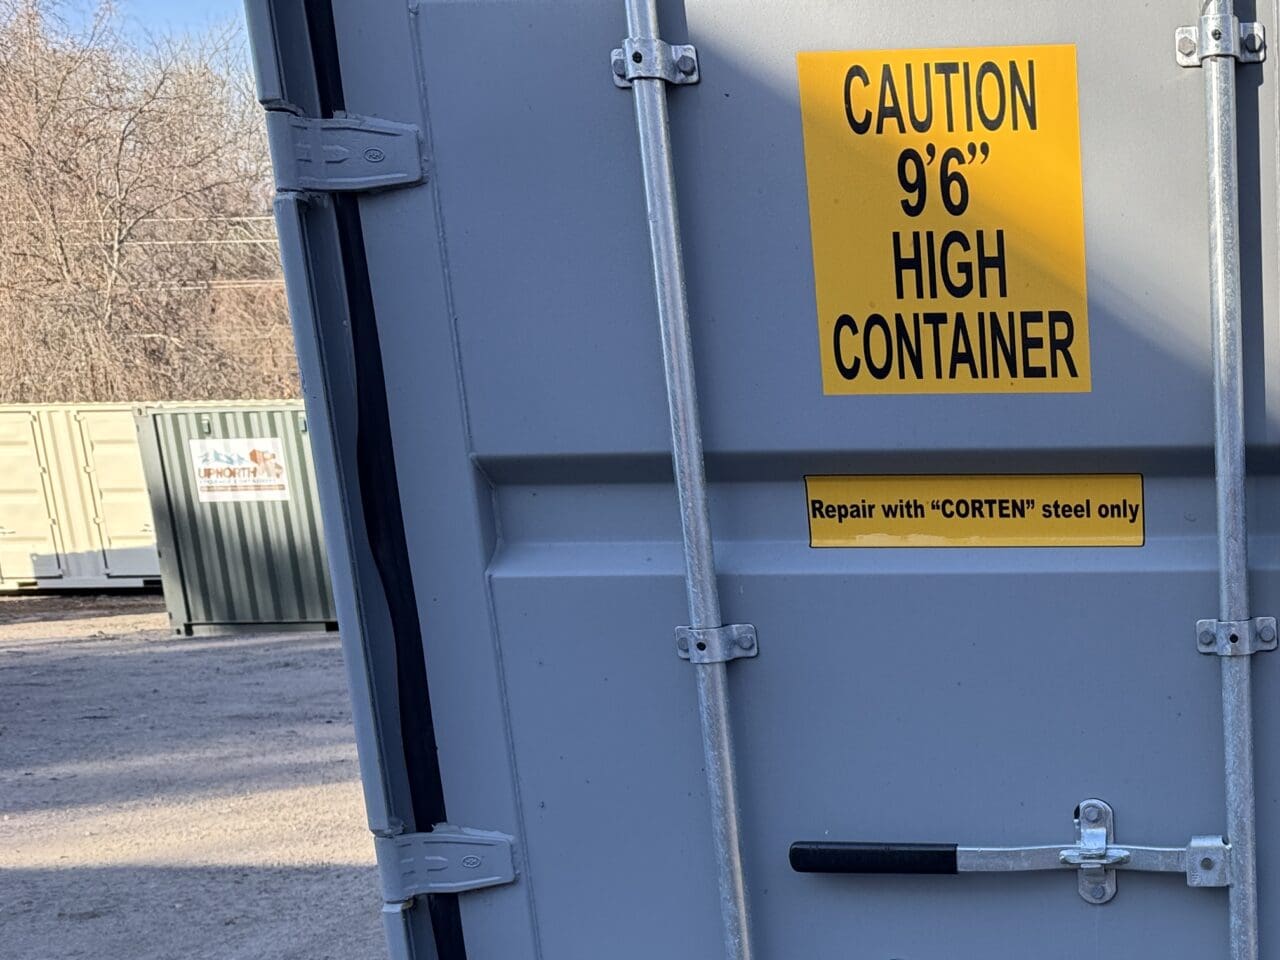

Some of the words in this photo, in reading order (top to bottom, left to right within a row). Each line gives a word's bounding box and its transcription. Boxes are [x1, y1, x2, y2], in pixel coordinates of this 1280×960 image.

[843, 60, 1037, 135] CAUTION
[892, 229, 1007, 300] HIGH
[833, 310, 1079, 381] CONTAINER
[811, 499, 876, 523] Repair
[882, 499, 925, 519] with
[1042, 499, 1091, 518] steel
[1098, 499, 1140, 523] only
